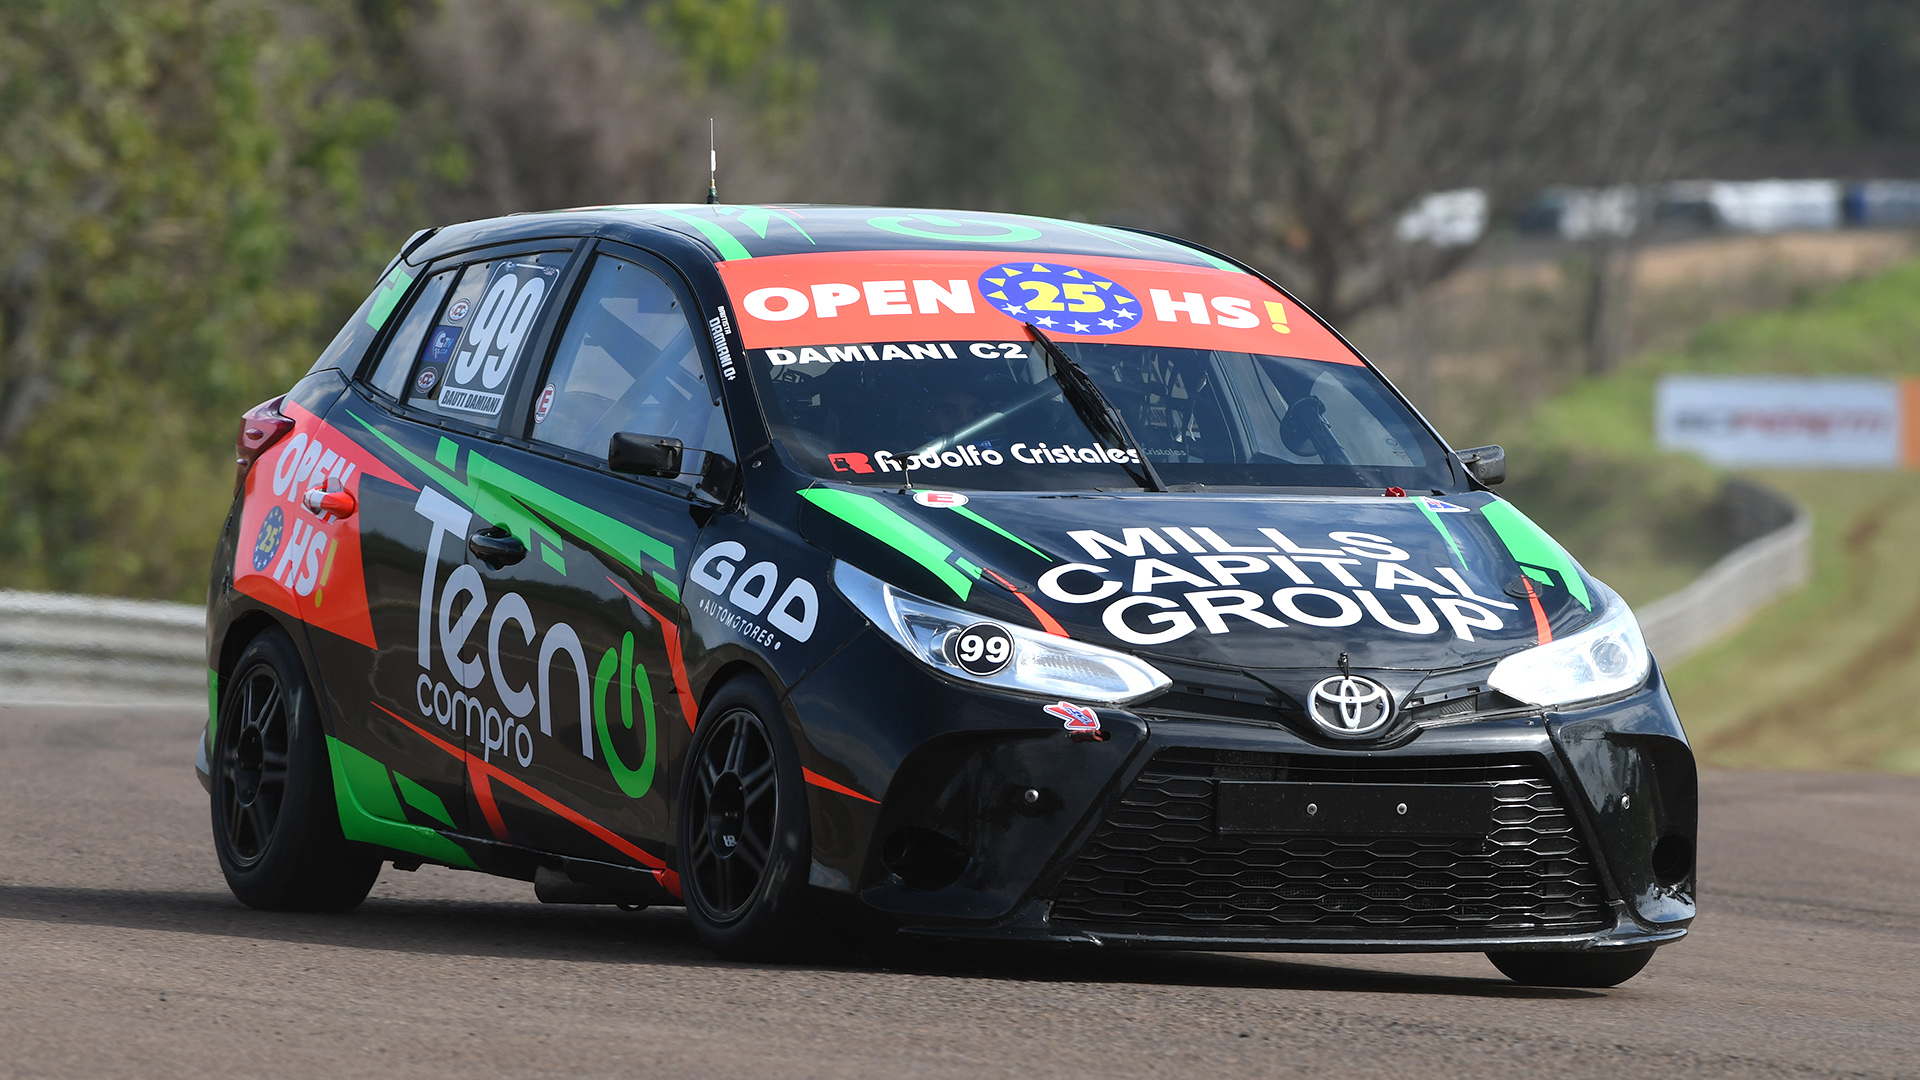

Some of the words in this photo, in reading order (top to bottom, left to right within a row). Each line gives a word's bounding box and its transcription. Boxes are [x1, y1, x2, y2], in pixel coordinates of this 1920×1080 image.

[743, 279, 976, 321] OPEN
[1018, 281, 1106, 313] 25
[1149, 288, 1291, 334] HS!
[454, 273, 545, 389] 99
[709, 316, 733, 368] DAMIANI
[764, 343, 958, 366] DAMIANI
[968, 342, 1028, 359] C2
[441, 389, 468, 408] BAUTI
[463, 393, 501, 413] DAMIANI
[538, 390, 552, 412] E
[874, 444, 1003, 473] Rodolfo
[1010, 442, 1140, 465] Cristales
[927, 493, 954, 503] E
[259, 524, 279, 553] 25
[272, 517, 338, 608] HS!
[1066, 526, 1411, 562] MILLS
[1037, 554, 1520, 610] CAPITAL
[1101, 587, 1505, 646] GROUP
[960, 635, 1010, 663] 99
[416, 674, 533, 768] compro
